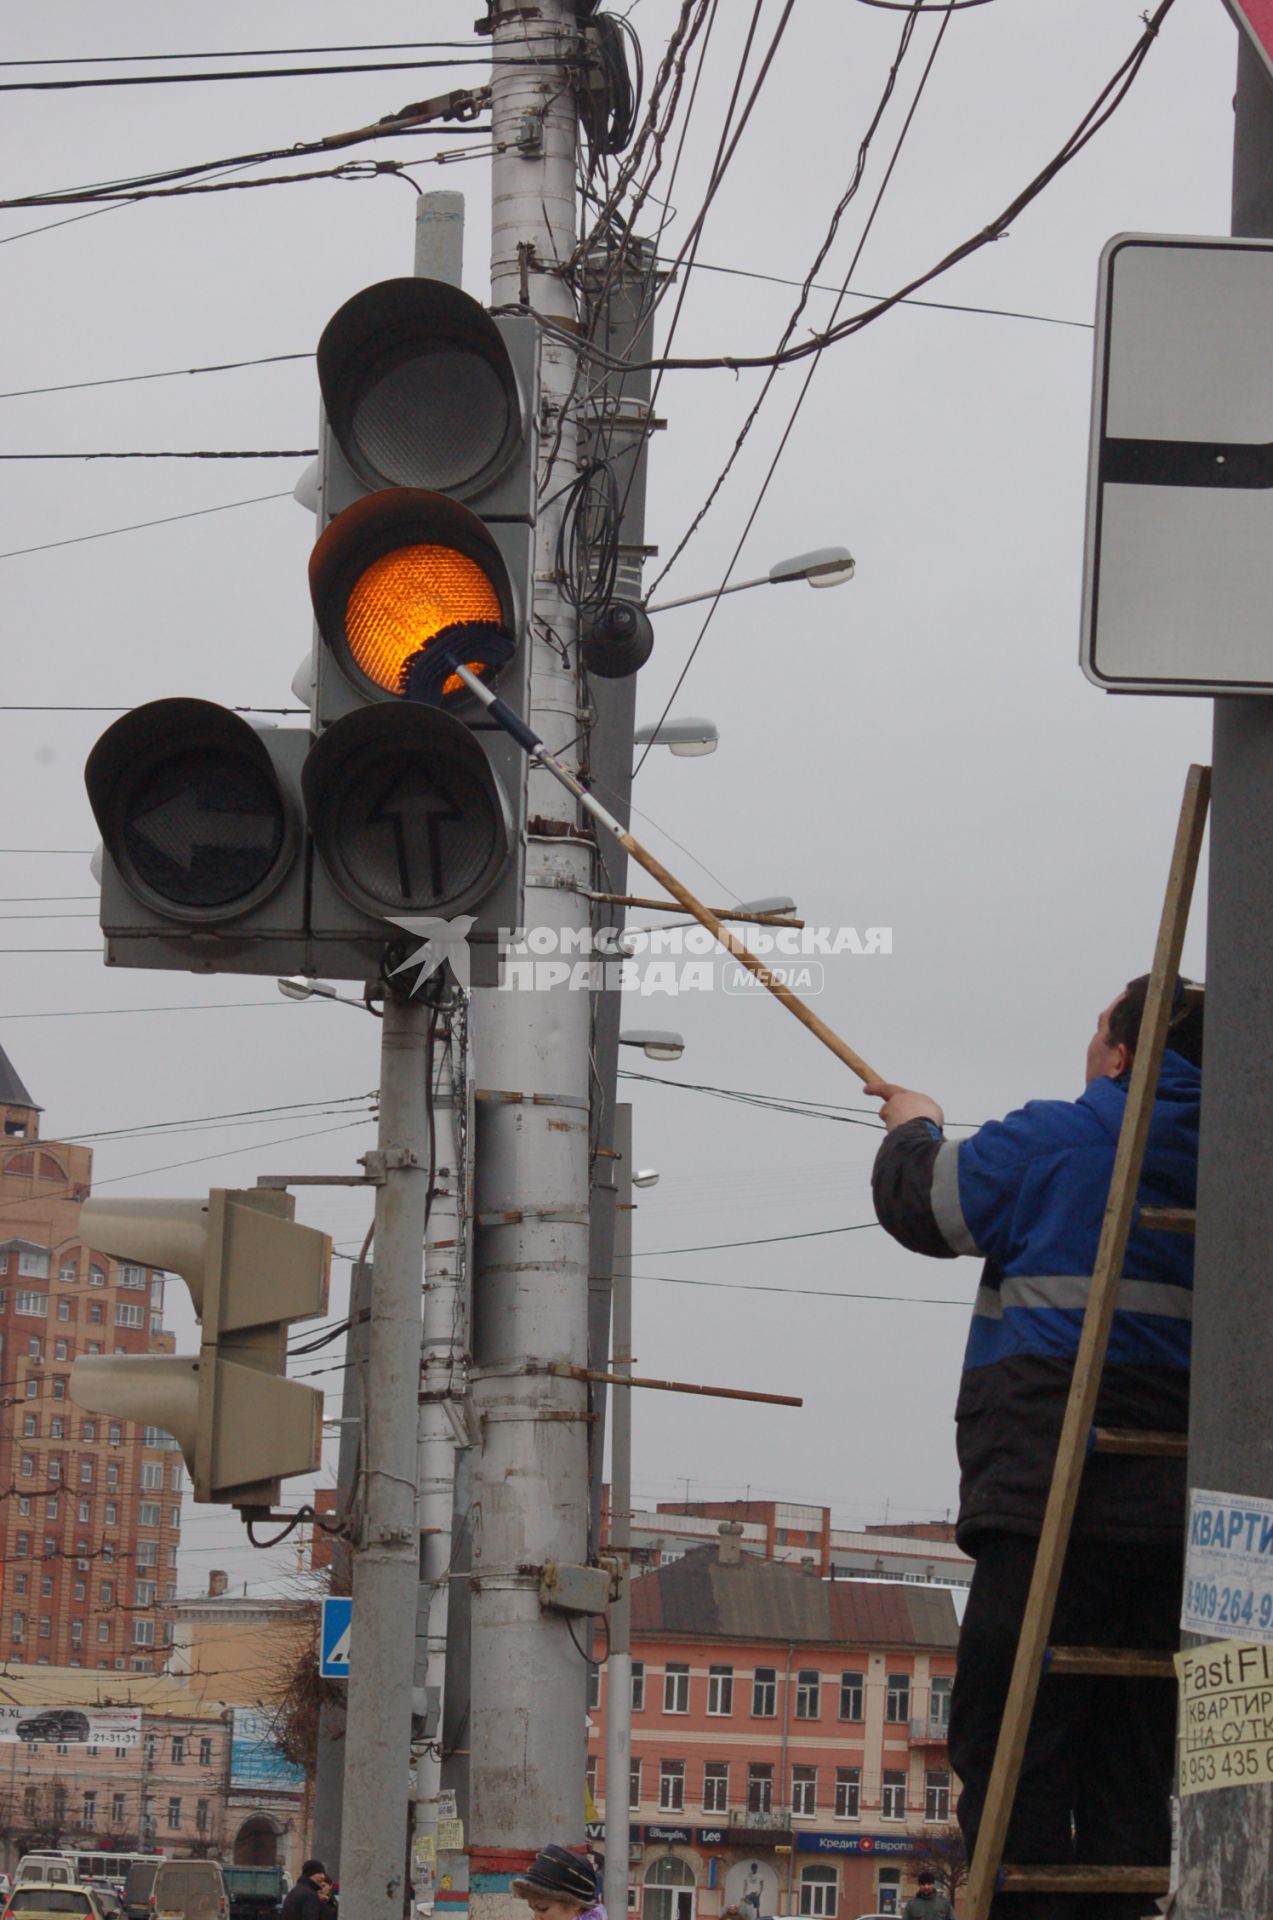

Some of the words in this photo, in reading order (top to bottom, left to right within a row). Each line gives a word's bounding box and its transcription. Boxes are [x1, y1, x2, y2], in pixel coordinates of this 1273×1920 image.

[94, 1733, 136, 1743] 21-31-31
[1193, 1725, 1216, 1749] НА
[1181, 1760, 1187, 1787] 8
[1190, 1754, 1216, 1784] 953
[1221, 1748, 1259, 1777] 435
[702, 1830, 721, 1842] Lee
[819, 1837, 858, 1850] Кредит
